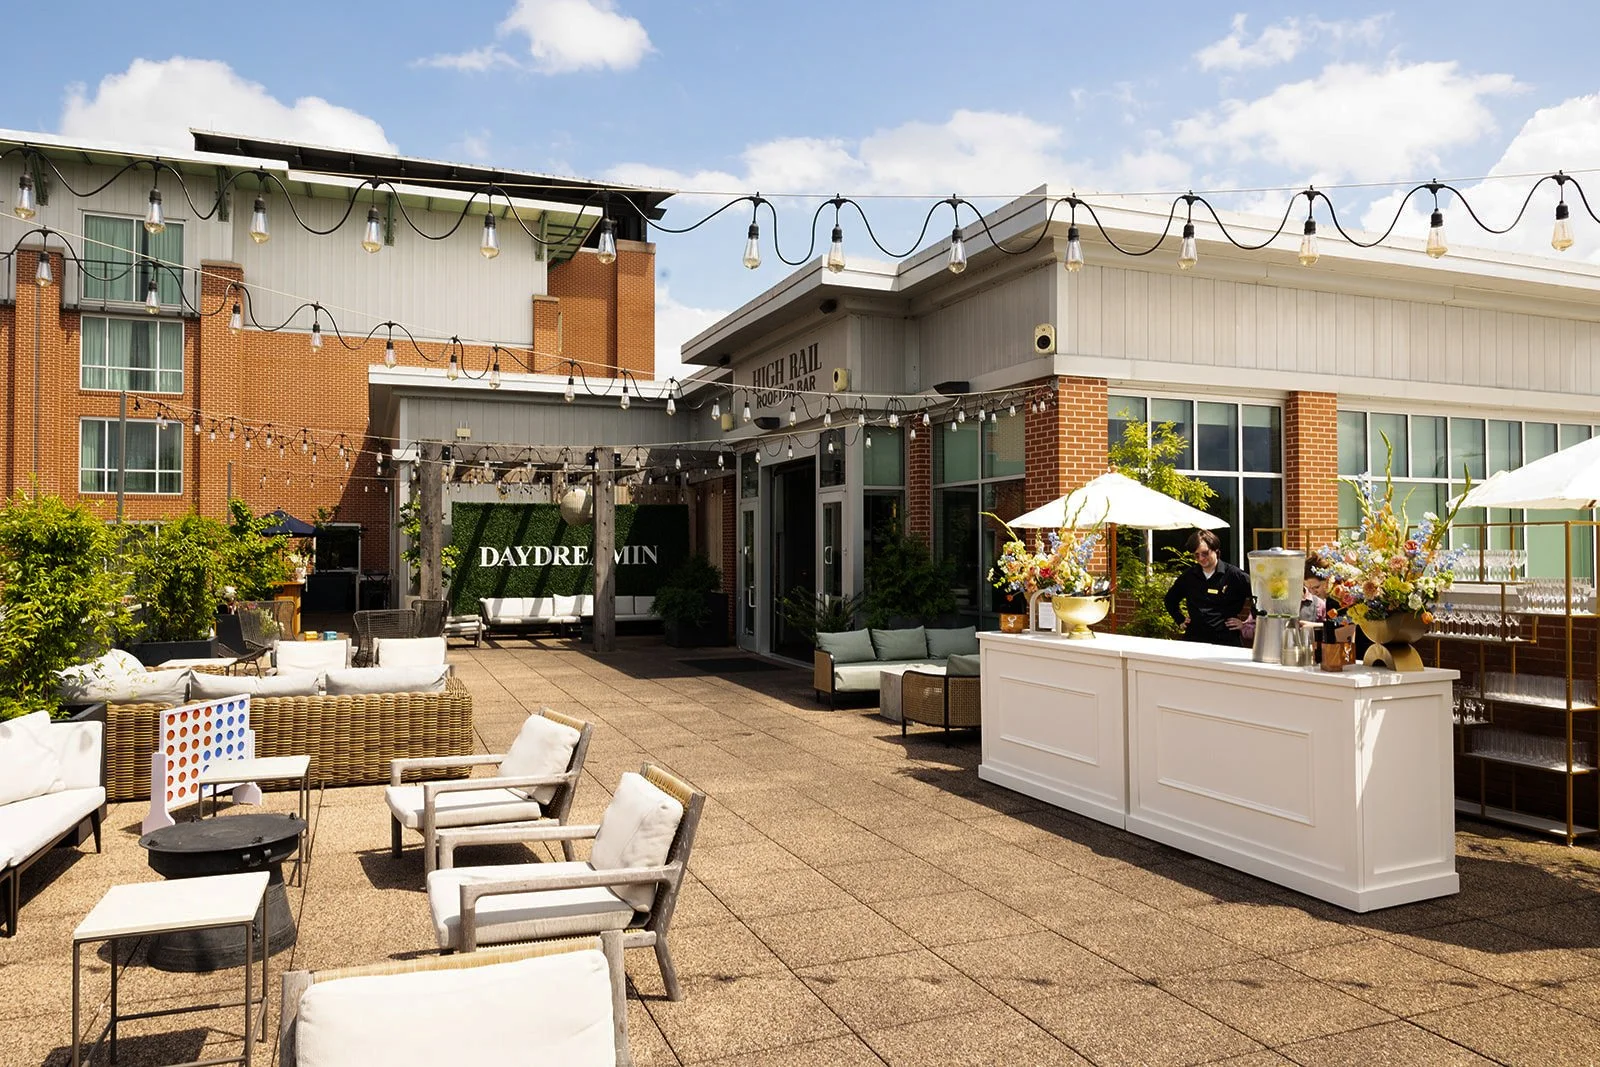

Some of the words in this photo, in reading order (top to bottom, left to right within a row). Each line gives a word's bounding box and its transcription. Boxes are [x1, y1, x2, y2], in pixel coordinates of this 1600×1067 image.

[752, 358, 785, 392] HIGH
[789, 342, 822, 380] RAIL
[796, 375, 816, 392] BAR
[479, 545, 658, 567] DAYDREMIN
